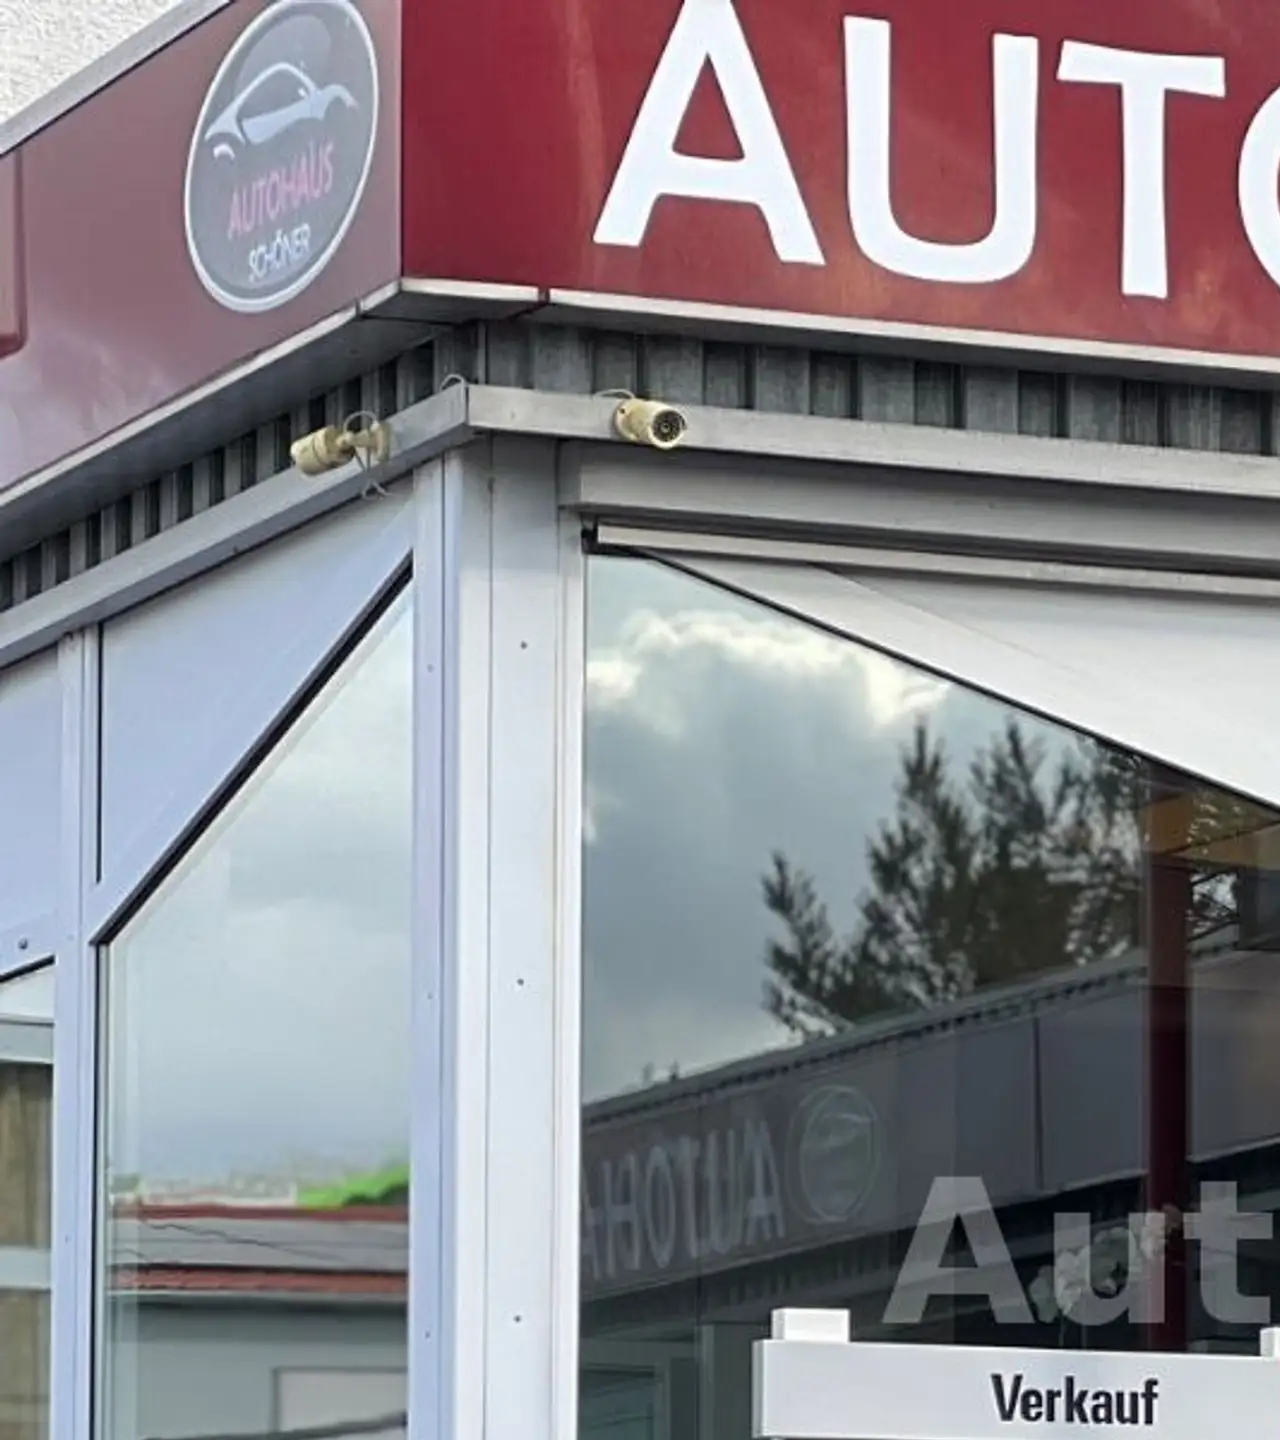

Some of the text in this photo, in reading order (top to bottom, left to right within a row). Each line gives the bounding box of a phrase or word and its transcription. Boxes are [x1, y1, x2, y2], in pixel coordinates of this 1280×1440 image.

[227, 139, 334, 241] AUTOHAUS
[248, 224, 311, 282] SCHÖNER
[990, 1373, 1159, 1426] Verkauf
